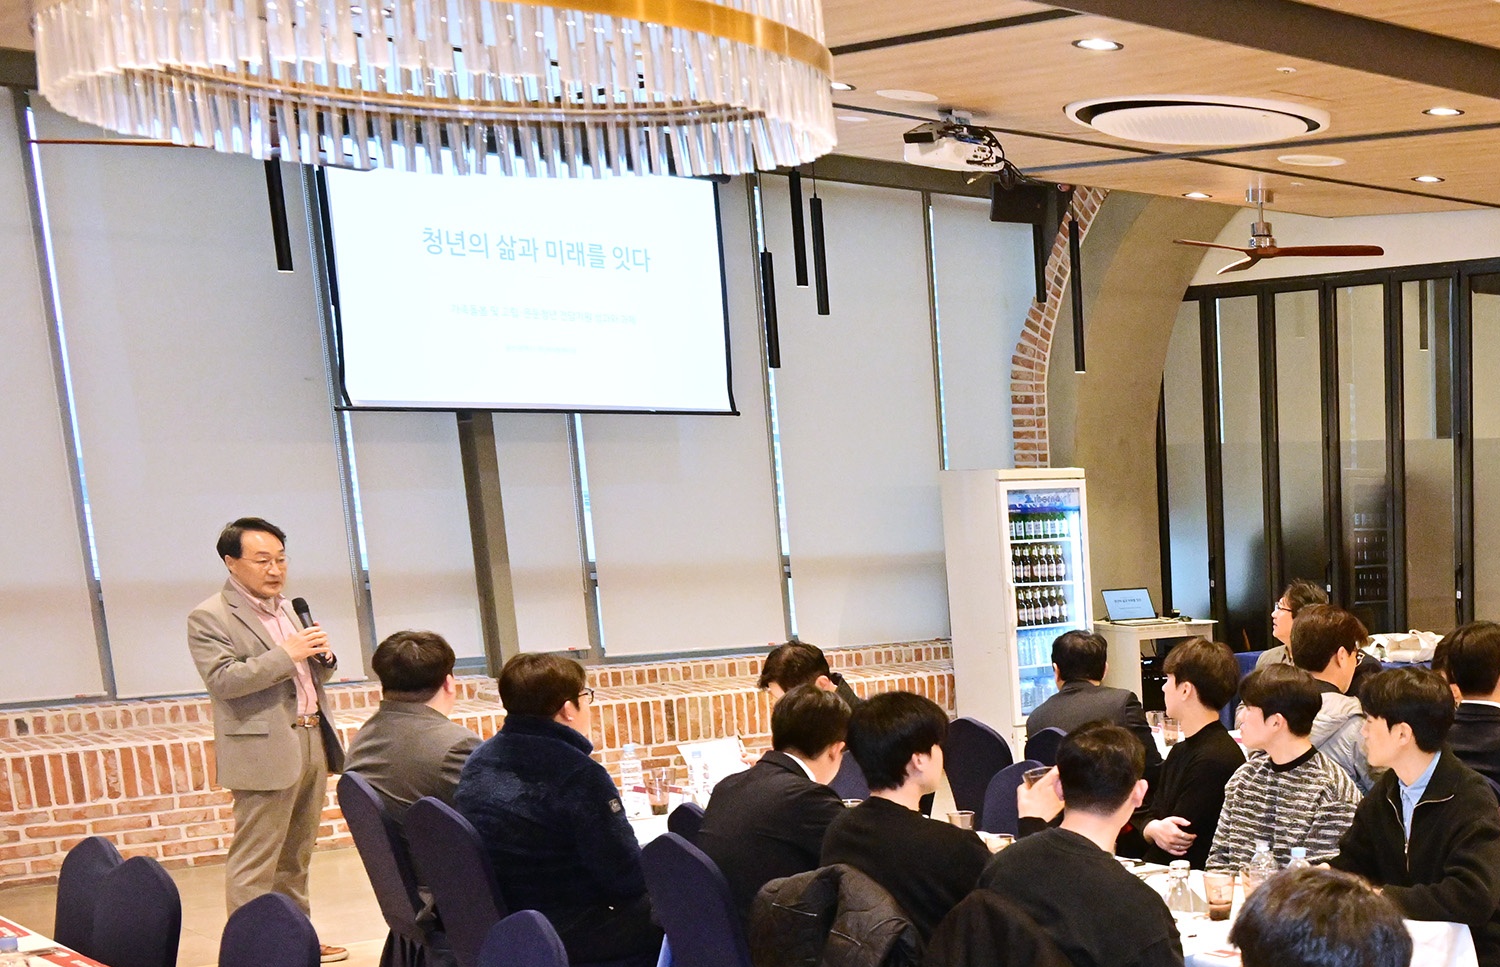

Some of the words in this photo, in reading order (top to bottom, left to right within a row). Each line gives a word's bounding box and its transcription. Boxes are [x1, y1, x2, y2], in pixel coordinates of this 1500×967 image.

[422, 226, 490, 260] 청년의
[495, 234, 540, 263] 삶과
[545, 239, 607, 270] 미래를
[611, 246, 651, 273] 잇다
